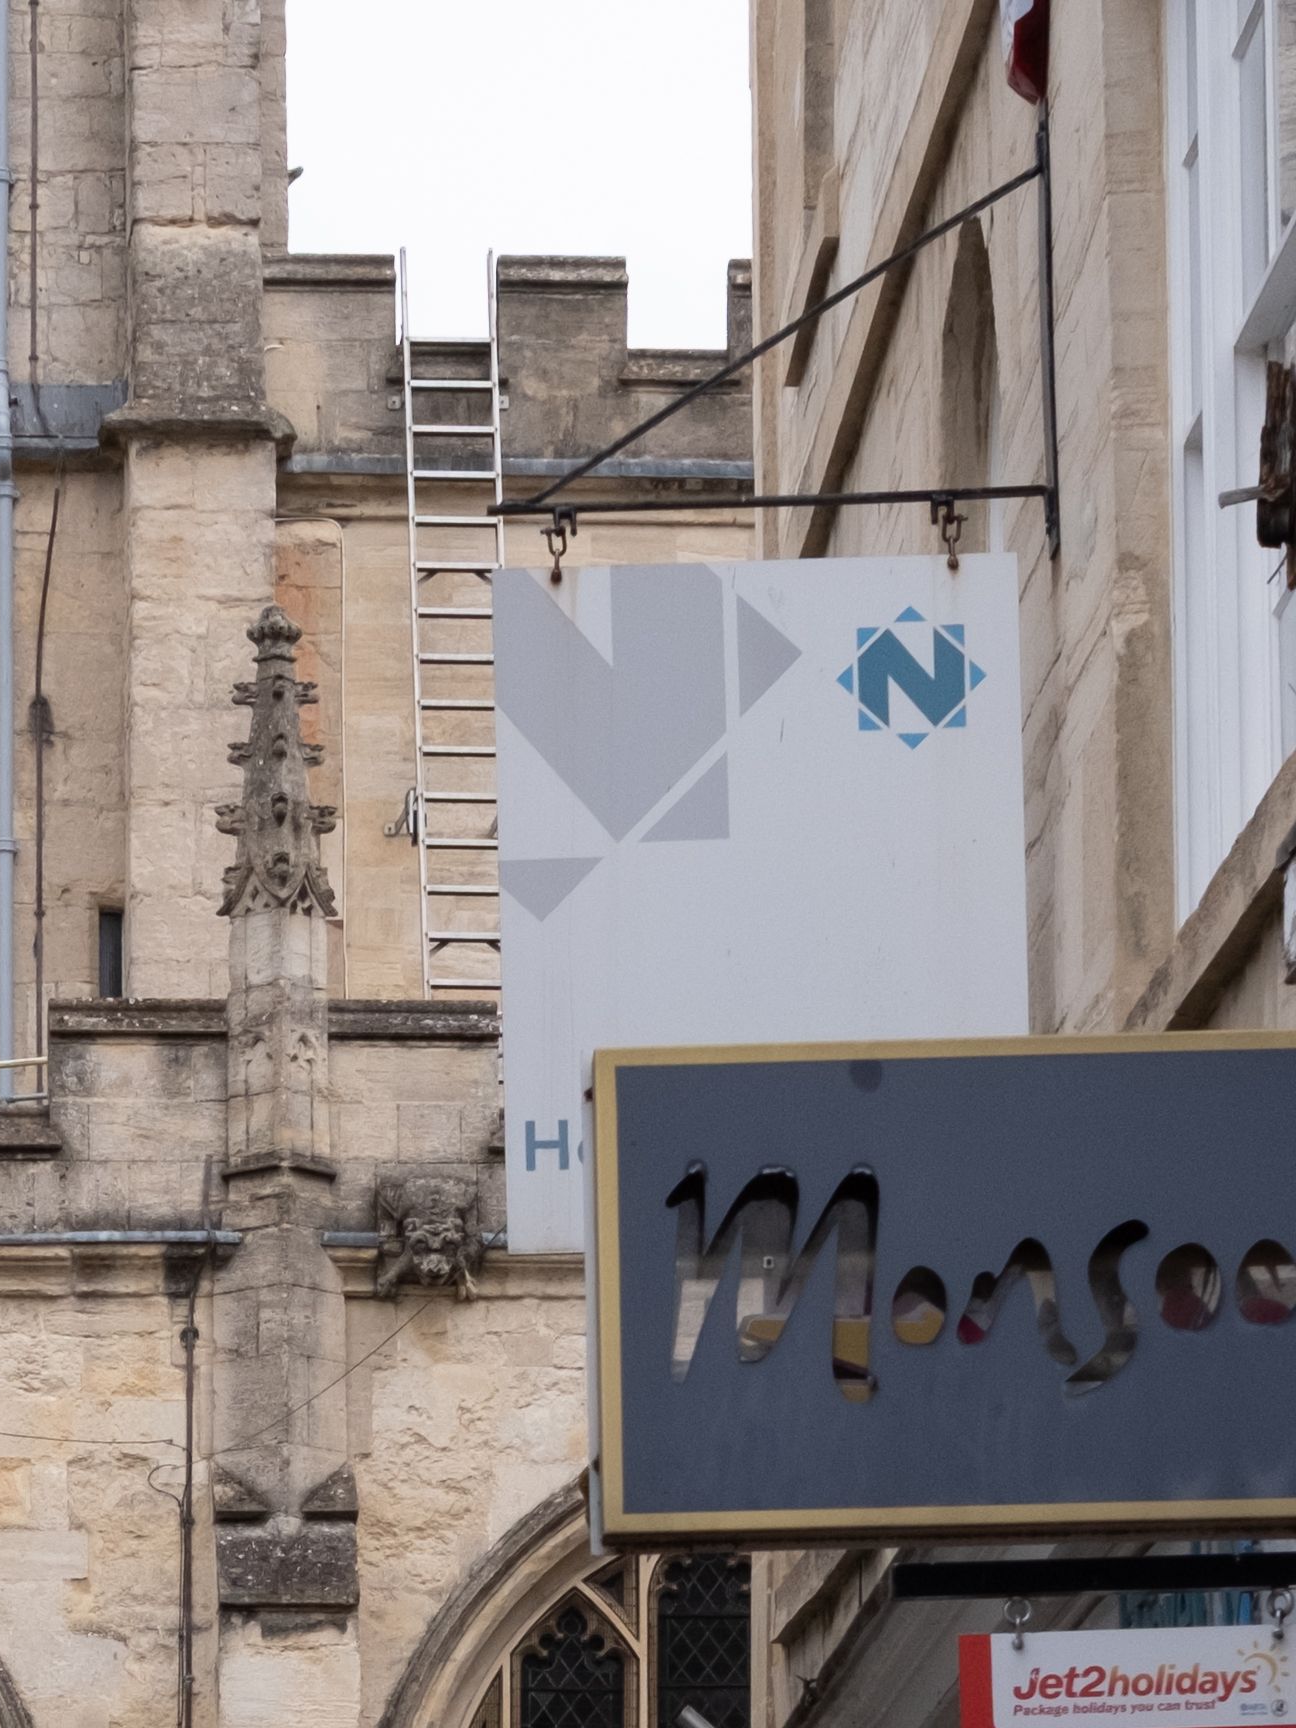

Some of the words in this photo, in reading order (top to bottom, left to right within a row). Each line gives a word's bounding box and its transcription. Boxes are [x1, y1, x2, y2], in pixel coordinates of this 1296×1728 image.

[525, 1119, 585, 1172] H
[1012, 1663, 1258, 1702] Jet2holidays
[1013, 1703, 1069, 1717] Package
[1072, 1701, 1127, 1714] holidays
[1130, 1702, 1154, 1713] you
[1157, 1702, 1181, 1711] can
[1184, 1699, 1217, 1711] trust
